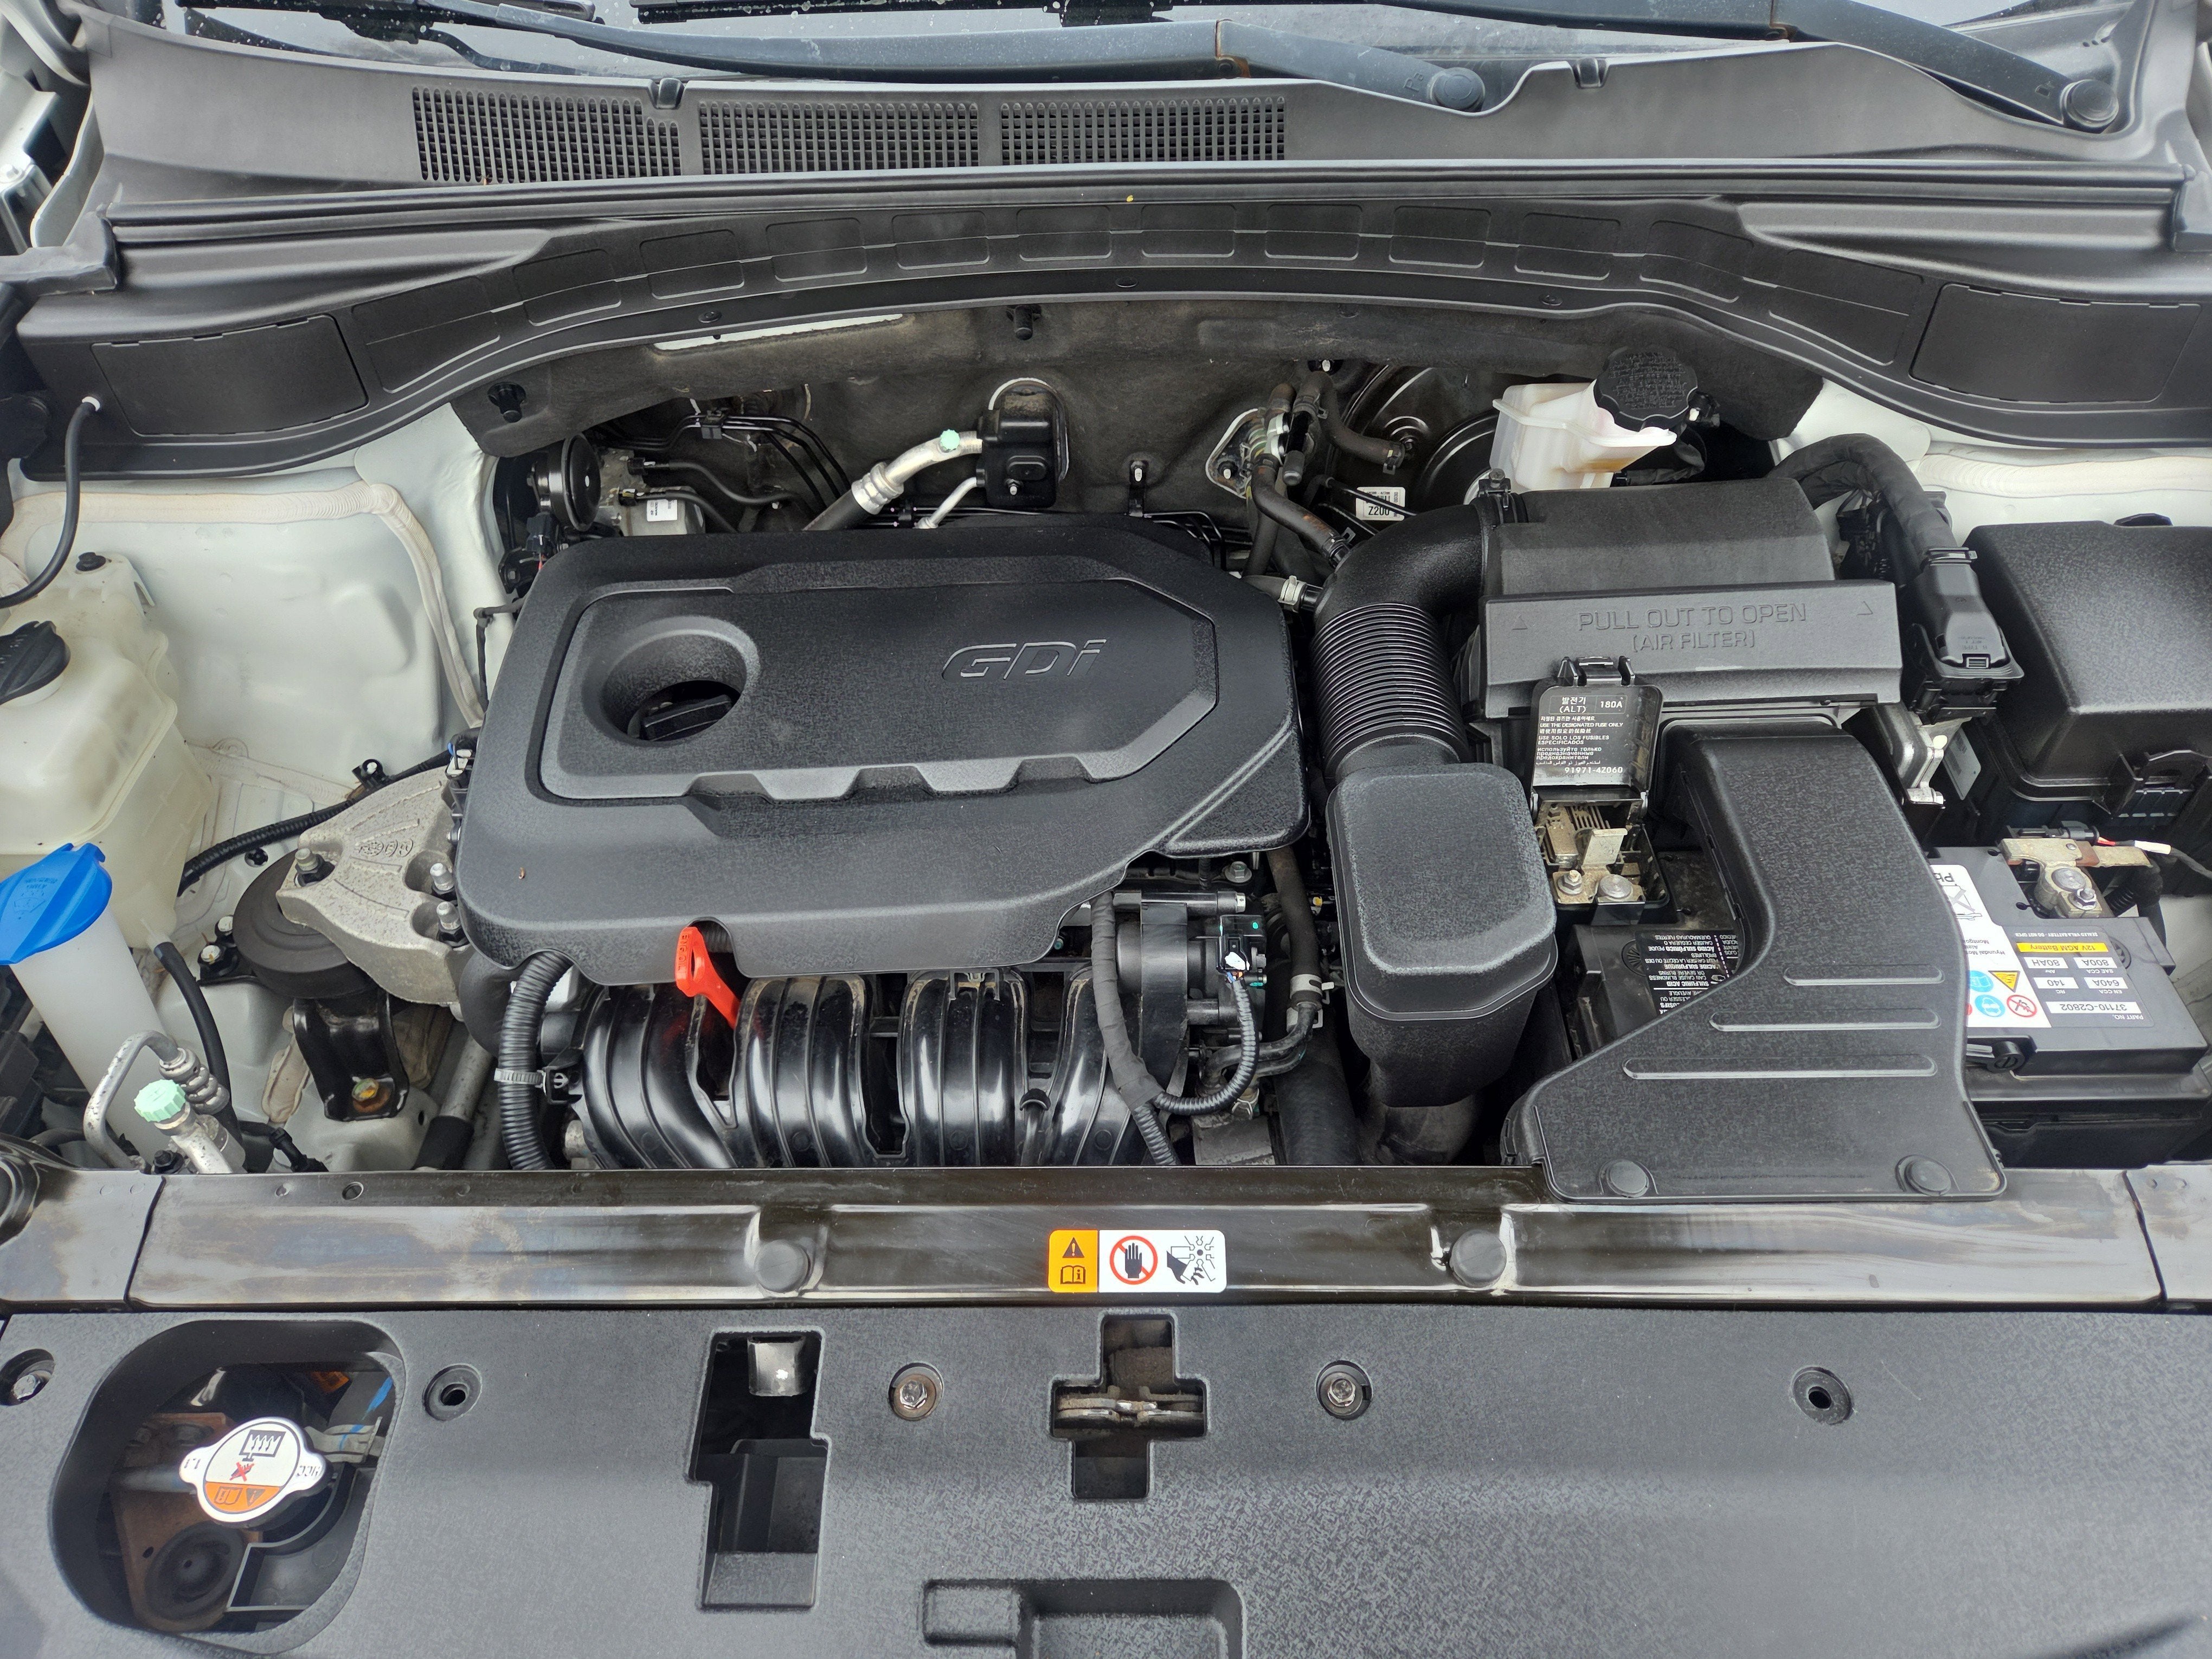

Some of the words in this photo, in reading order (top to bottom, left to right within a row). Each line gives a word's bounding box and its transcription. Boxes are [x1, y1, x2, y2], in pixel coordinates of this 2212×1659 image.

[1579, 611, 1639, 631] PULL
[1648, 608, 1694, 627] OUT
[1701, 606, 1733, 625] TO
[1742, 603, 1806, 623] OPEN
[1633, 634, 1673, 652] (AIR
[1681, 630, 1756, 648] FILTER)
[1562, 697, 1586, 705] 발전기
